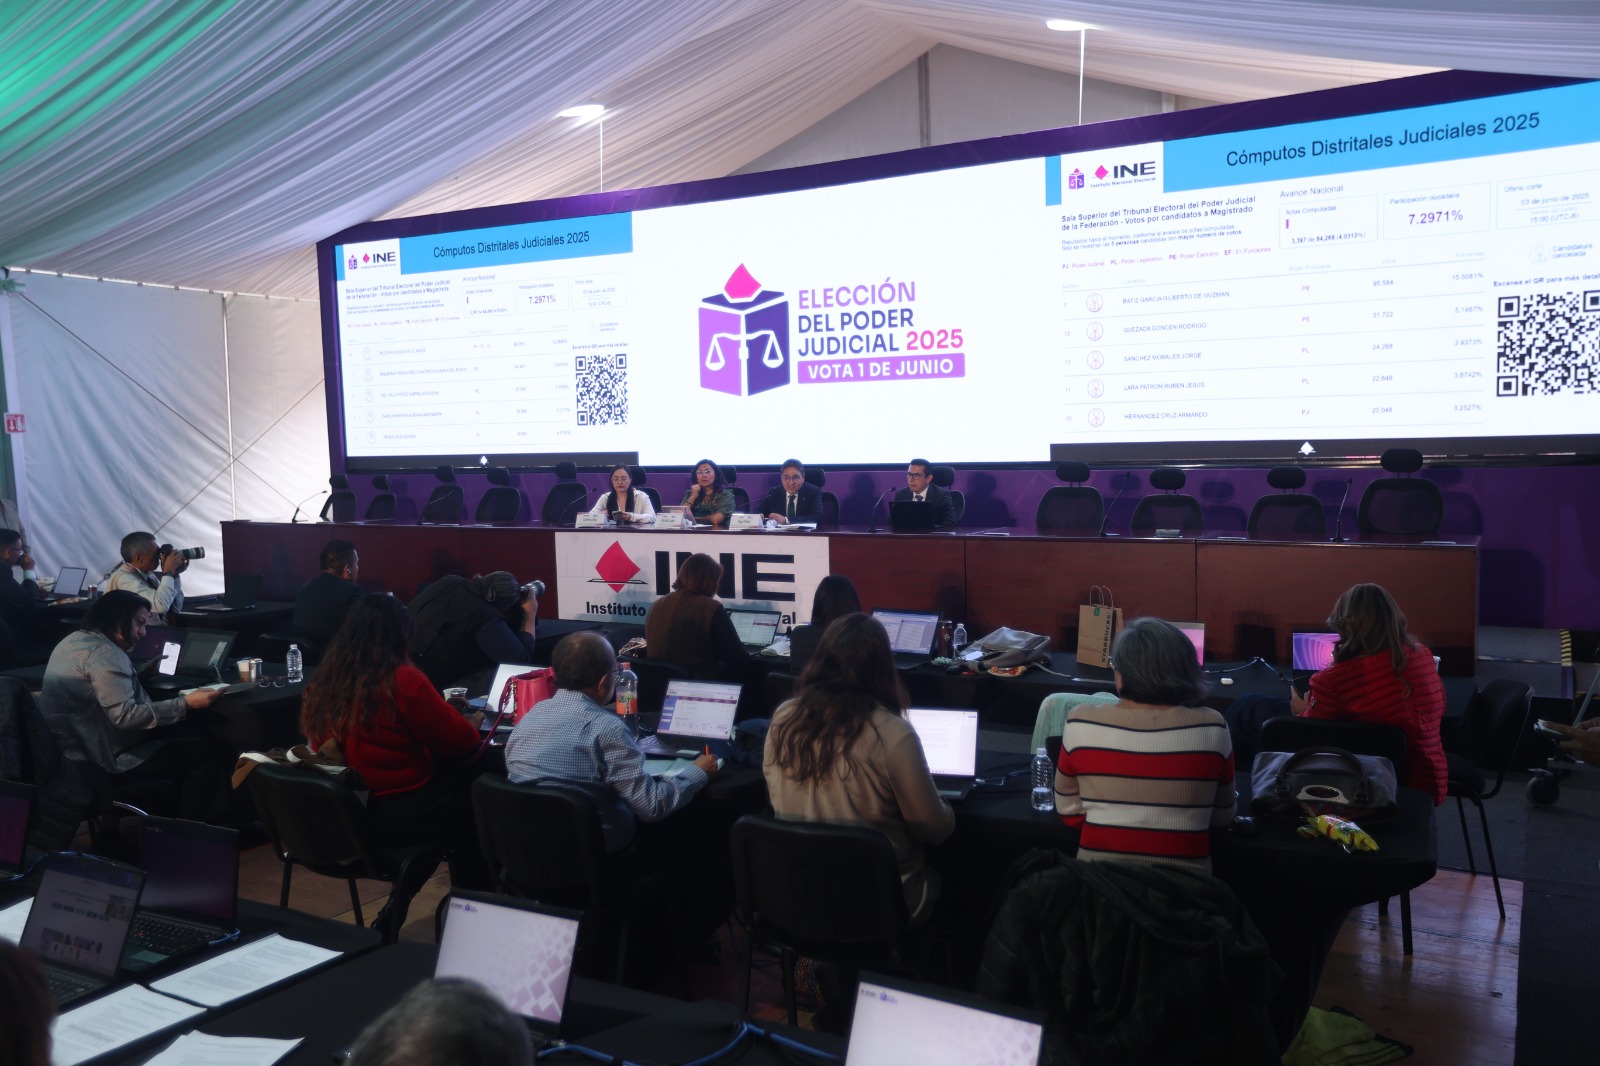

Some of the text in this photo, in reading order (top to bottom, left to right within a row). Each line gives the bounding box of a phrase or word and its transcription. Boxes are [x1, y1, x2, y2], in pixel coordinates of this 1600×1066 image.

[1226, 112, 1540, 167] Cómputos Distritales Judiciales 2025
[1113, 162, 1156, 179] INE
[1280, 184, 1344, 198] Avance Nacional
[1078, 212, 1108, 221] Superior
[1123, 207, 1151, 215] Tribunal
[1154, 203, 1186, 212] Electoral
[1226, 196, 1255, 205] Judicial
[1080, 220, 1118, 228] Federación
[1162, 212, 1202, 220] candidatos
[1210, 206, 1253, 216] Magistrado
[1408, 209, 1464, 225] 7.2971%
[433, 231, 590, 258] Cómputos Distritales Judiciales 2025
[373, 252, 396, 264] INE
[528, 295, 556, 304] 7.2971%
[799, 277, 916, 309] ELECCIÓN
[798, 308, 914, 333] DEL PODER
[798, 329, 964, 357] JUDICIAL 2025
[808, 359, 953, 379] VOTA 1 DE JUNIO
[586, 601, 647, 617] Instituto
[1102, 612, 1111, 663] STARBUCKS
